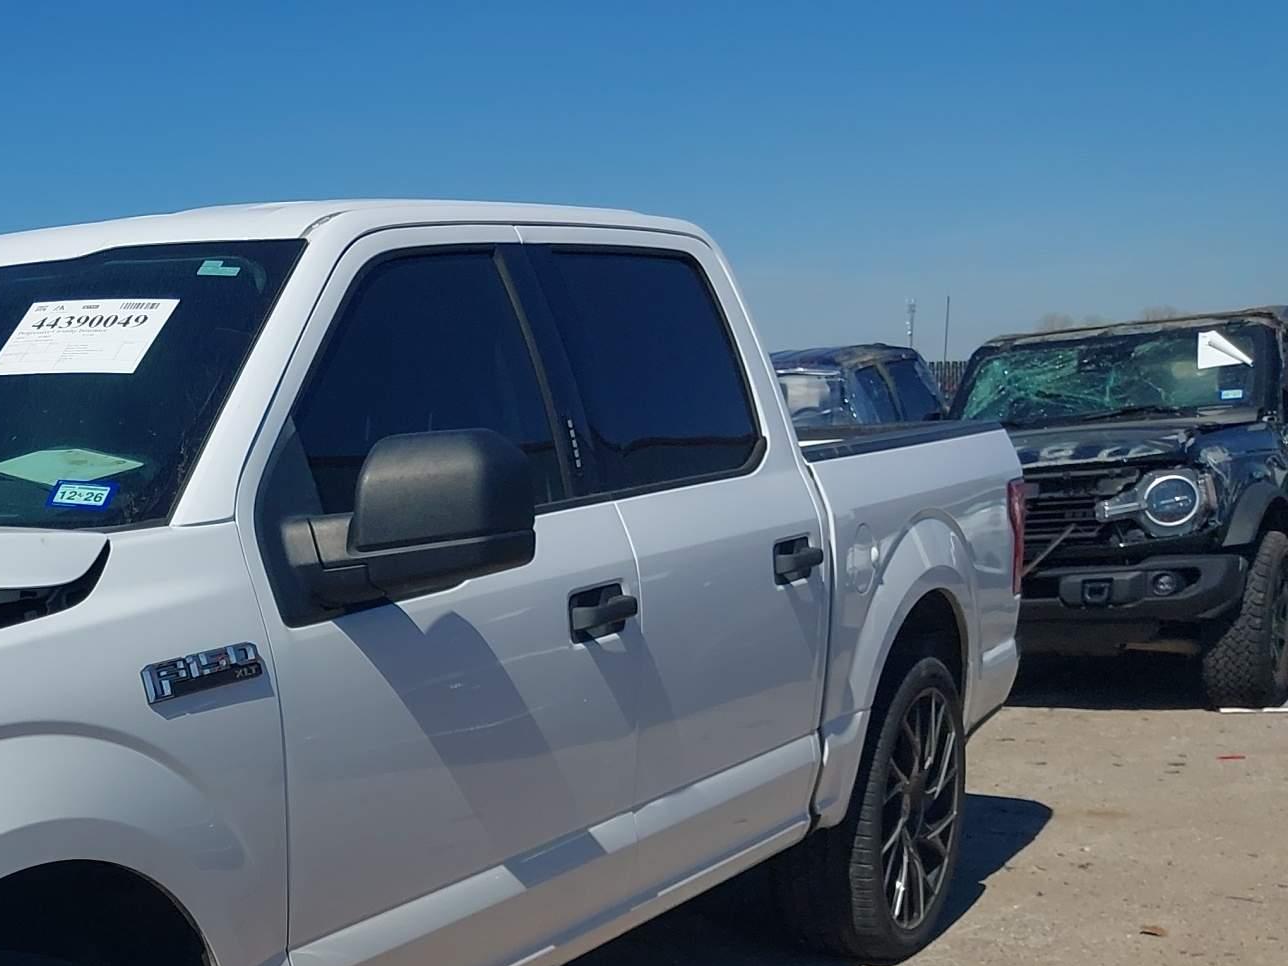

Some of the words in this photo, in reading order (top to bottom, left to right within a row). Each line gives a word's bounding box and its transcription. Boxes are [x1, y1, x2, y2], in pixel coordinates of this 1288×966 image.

[32, 314, 149, 330] 44390049
[59, 490, 77, 501] 12
[83, 491, 105, 503] 26
[234, 664, 259, 679] XLT
